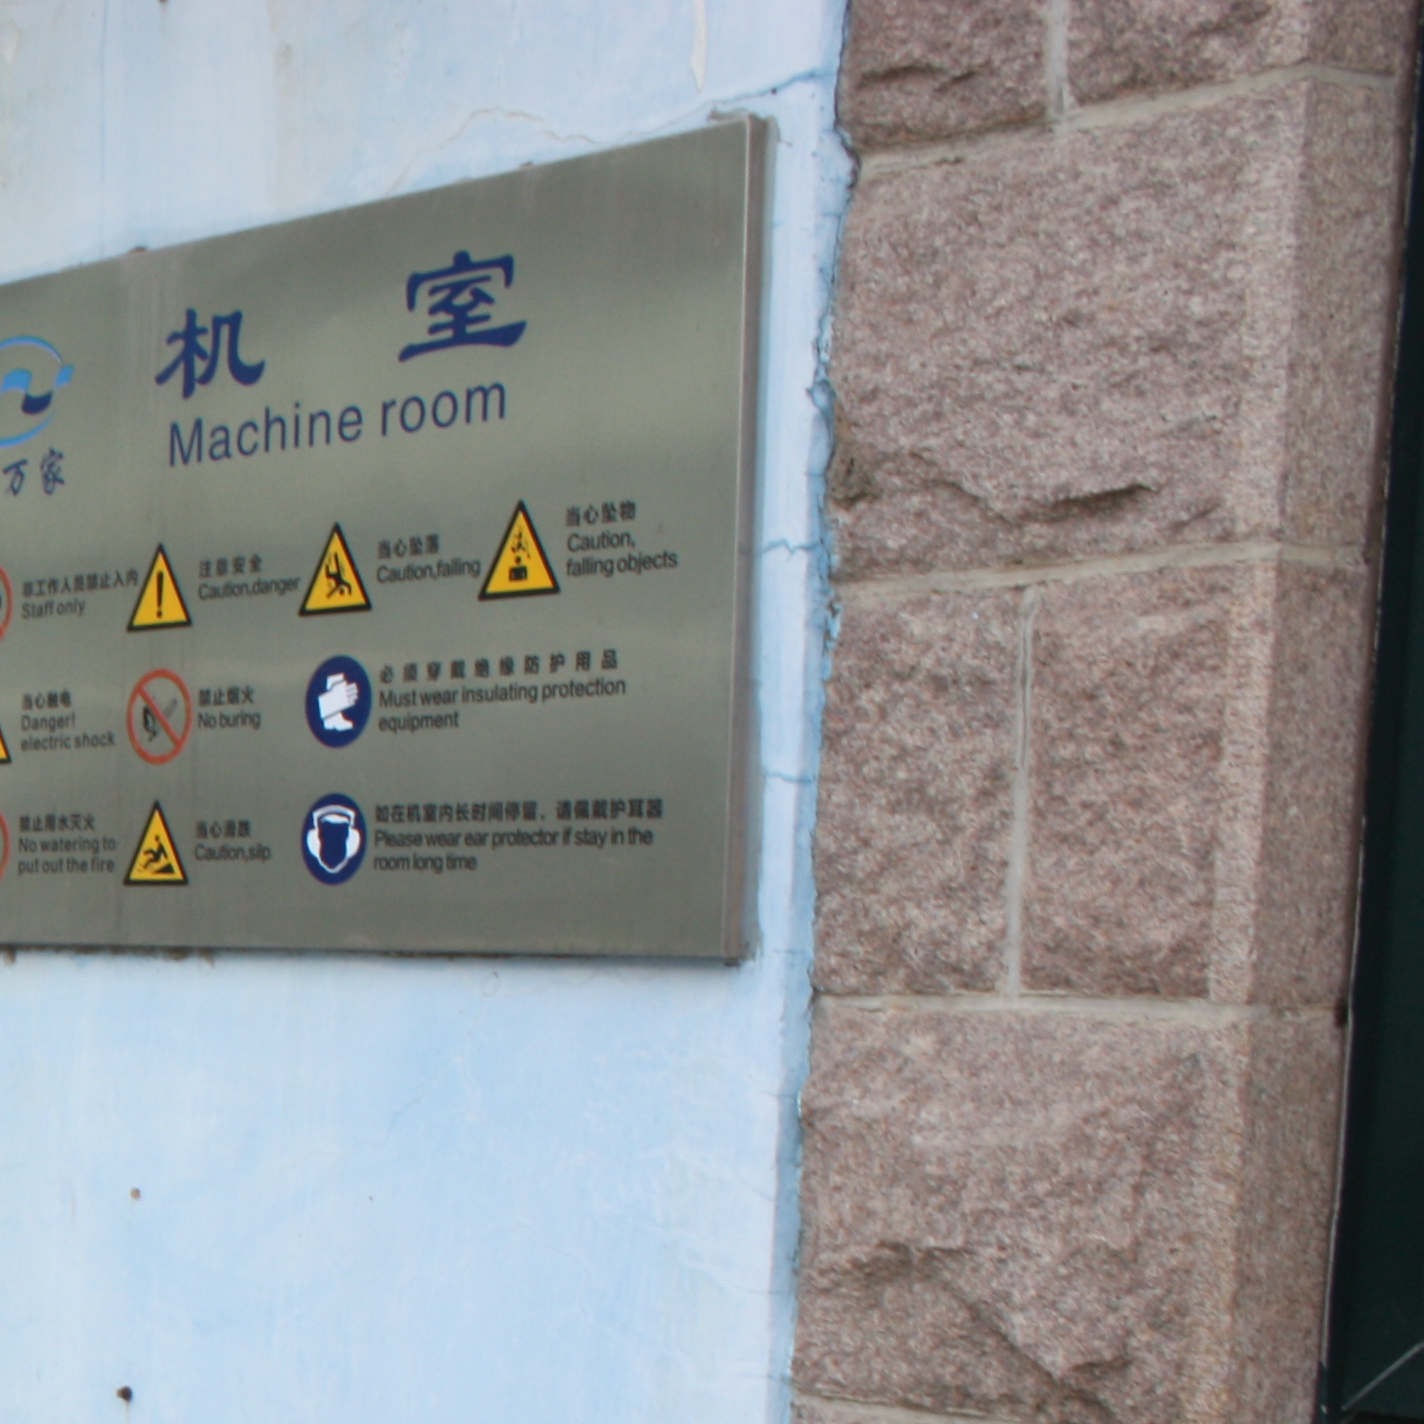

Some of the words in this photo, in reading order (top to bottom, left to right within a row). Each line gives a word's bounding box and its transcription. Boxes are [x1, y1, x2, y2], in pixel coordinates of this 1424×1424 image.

[169, 402, 363, 467] Machine
[380, 381, 507, 437] room
[566, 530, 636, 554] Caution,
[565, 556, 614, 578] falling
[616, 550, 678, 574] objects
[21, 600, 54, 619] Staff
[56, 598, 86, 617] only
[378, 690, 416, 709] Must
[419, 690, 459, 706] wear
[461, 683, 538, 705] insulating
[540, 677, 626, 703] protection
[20, 712, 76, 733] Danger!
[197, 712, 217, 729] No
[378, 711, 459, 733] equipment
[20, 734, 72, 752] electric
[74, 730, 116, 749] shock
[18, 836, 36, 853] No
[38, 836, 98, 855] watering
[101, 836, 116, 851] to
[374, 829, 423, 847] Please
[425, 832, 461, 847] wear
[464, 832, 489, 847] ear
[492, 829, 559, 849] protector
[574, 828, 607, 849] stay
[610, 827, 626, 845] in
[628, 826, 654, 845] the
[18, 859, 39, 876] put
[41, 858, 64, 874] out
[66, 857, 88, 874] the
[90, 858, 114, 874] fire
[374, 855, 410, 870] room
[412, 853, 444, 874] long
[446, 854, 477, 870] time
